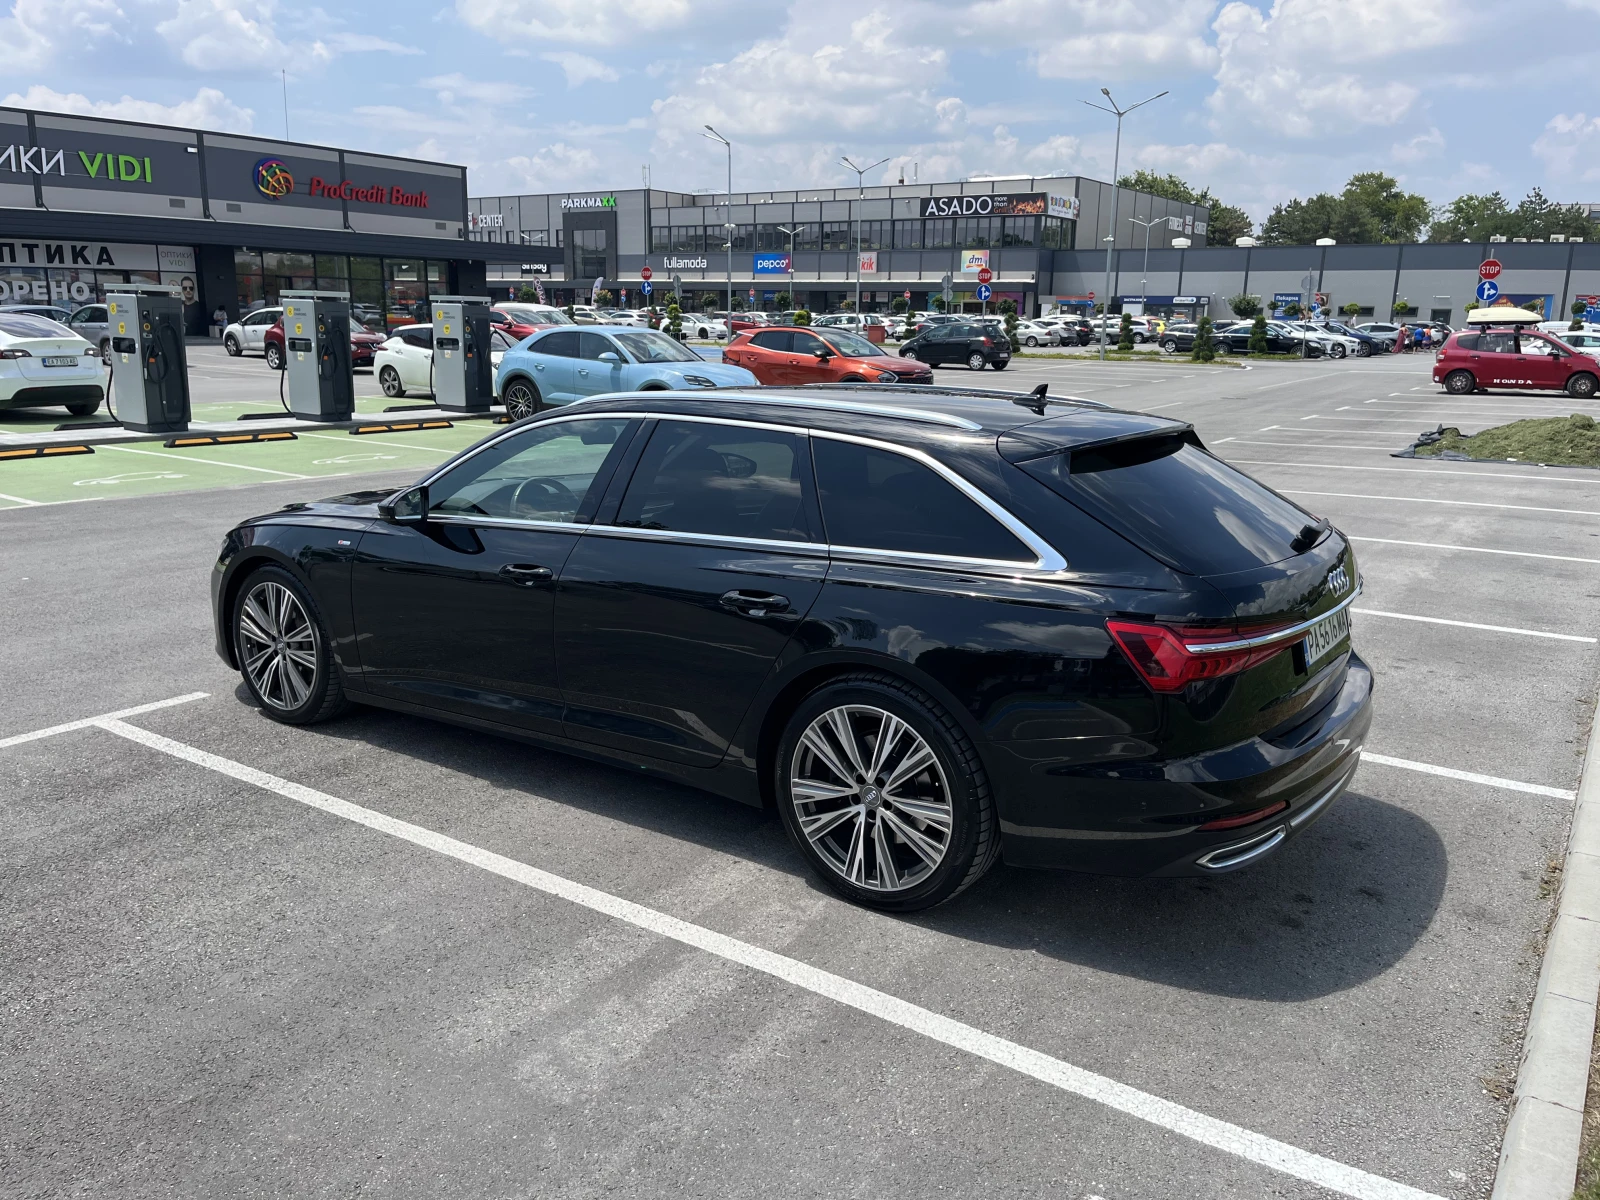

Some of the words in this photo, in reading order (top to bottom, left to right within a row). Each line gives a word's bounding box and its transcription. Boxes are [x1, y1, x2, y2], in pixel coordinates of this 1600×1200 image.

[78, 150, 152, 183] VIDI
[310, 176, 388, 204] ProCredit
[391, 186, 430, 209] Bank
[561, 196, 616, 209] PARKMAXX
[925, 196, 993, 217] ASADO
[479, 214, 503, 227] CENTER
[161, 251, 193, 259] ОПТИКИ
[968, 254, 983, 264] dm
[664, 256, 707, 269] fullamoda
[757, 258, 787, 270] pepco
[1480, 265, 1500, 274] STOP
